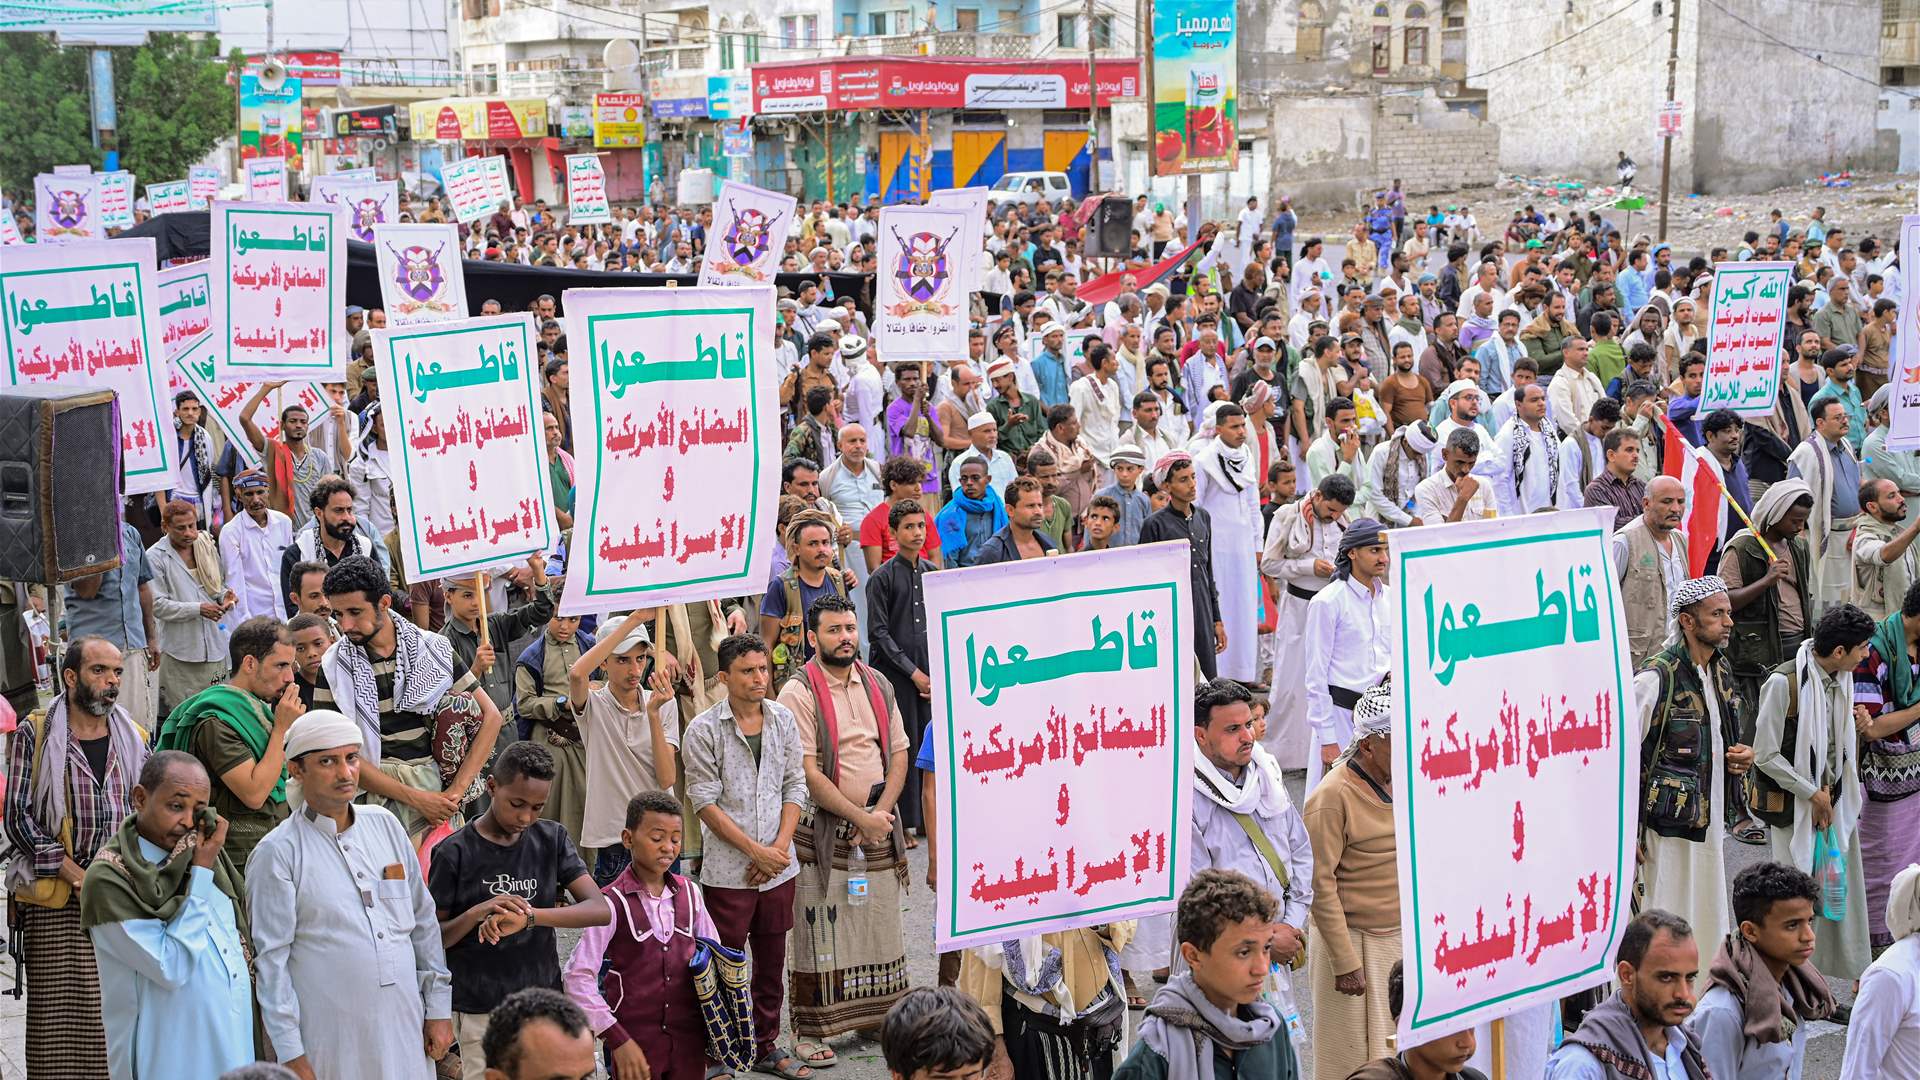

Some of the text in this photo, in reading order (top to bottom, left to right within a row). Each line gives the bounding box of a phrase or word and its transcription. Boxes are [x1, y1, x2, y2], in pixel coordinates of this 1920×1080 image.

[1175, 12, 1232, 37] طعم مميز
[598, 95, 641, 107] الزيلعي
[233, 224, 325, 255] قاطعوا
[232, 261, 325, 292] البضائع الأمريكية
[1718, 273, 1784, 308] الله أكبر
[8, 281, 136, 336] قاطعوا
[274, 296, 282, 318] و
[1716, 306, 1780, 327] الموت لأمريكا
[19, 339, 142, 381] البضائع الأمريكية
[234, 329, 325, 353] الإسرائيلية
[1712, 332, 1777, 353] الموت لإسرائيل
[404, 339, 520, 404] قاطعوا
[601, 333, 746, 399] قاطعوا
[1709, 356, 1774, 377] اللعنة على اليهود
[1707, 376, 1772, 405] النصر للإسلام
[409, 405, 529, 457] البضائع الأمريكية
[606, 402, 748, 456] البضائع الأمريكية
[468, 460, 478, 492] و
[663, 466, 674, 501] و
[425, 499, 540, 552] الإسرائيلية
[599, 512, 745, 571] الإسرائيلية
[1424, 565, 1600, 686] قاطعوا
[964, 608, 1158, 706] قاطعوا
[962, 705, 1166, 785] البضائع الأمريكية
[1421, 691, 1611, 794] البضائع الأمريكية
[1056, 784, 1070, 826] و
[1512, 801, 1524, 862] و
[482, 873, 538, 900] Bingo
[970, 830, 1165, 910] الإسرائيلية
[1434, 872, 1611, 989] الإسرائيلية
